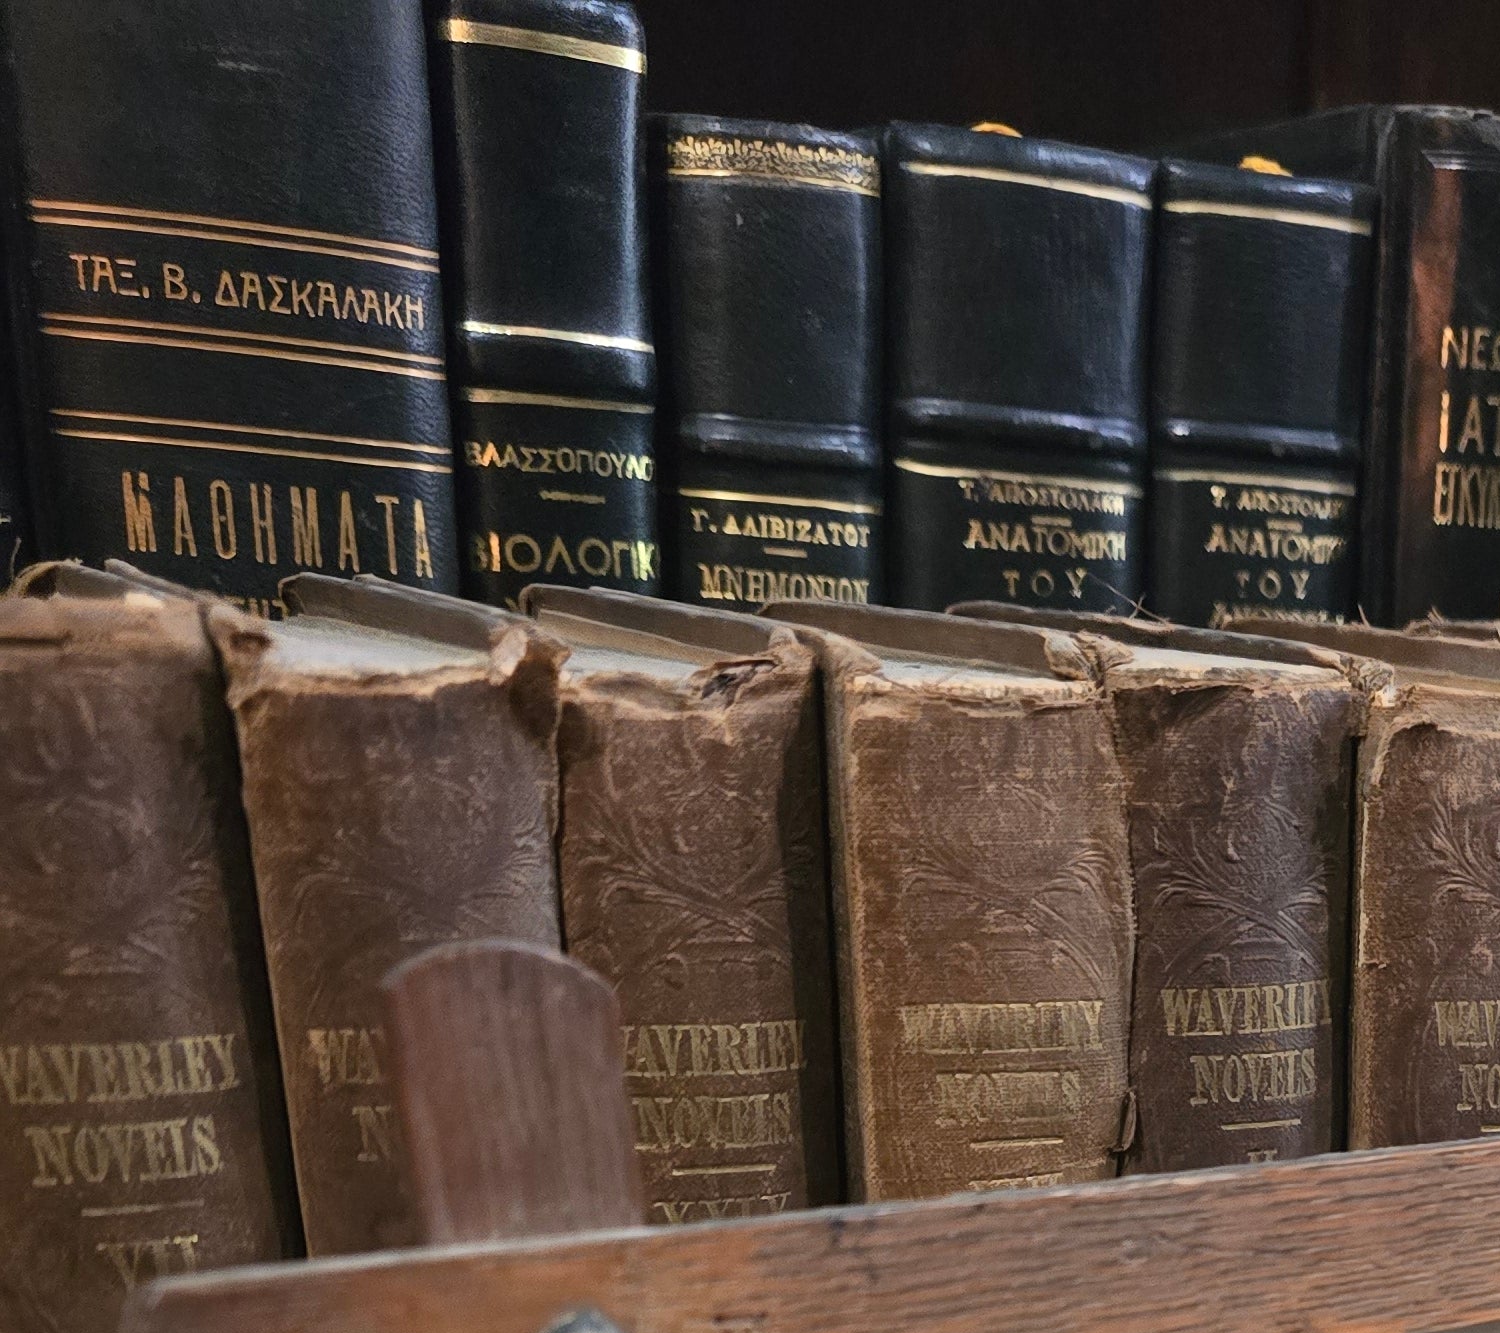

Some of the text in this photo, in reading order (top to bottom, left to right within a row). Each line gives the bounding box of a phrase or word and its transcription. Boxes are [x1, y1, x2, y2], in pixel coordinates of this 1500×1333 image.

[69, 253, 424, 330] ΤΑΞ. Β. ΔΑΣΚΑΛΑΚΗ
[122, 471, 434, 579] ΜΑΘΗΜΑΤΑ
[963, 518, 1126, 561] ΑΝΑΤΟΜΙΚΗ
[1002, 567, 1088, 599] ΤΟΥ
[1189, 1048, 1317, 1107] NOVELS
[24, 1115, 224, 1187] NOVELS
